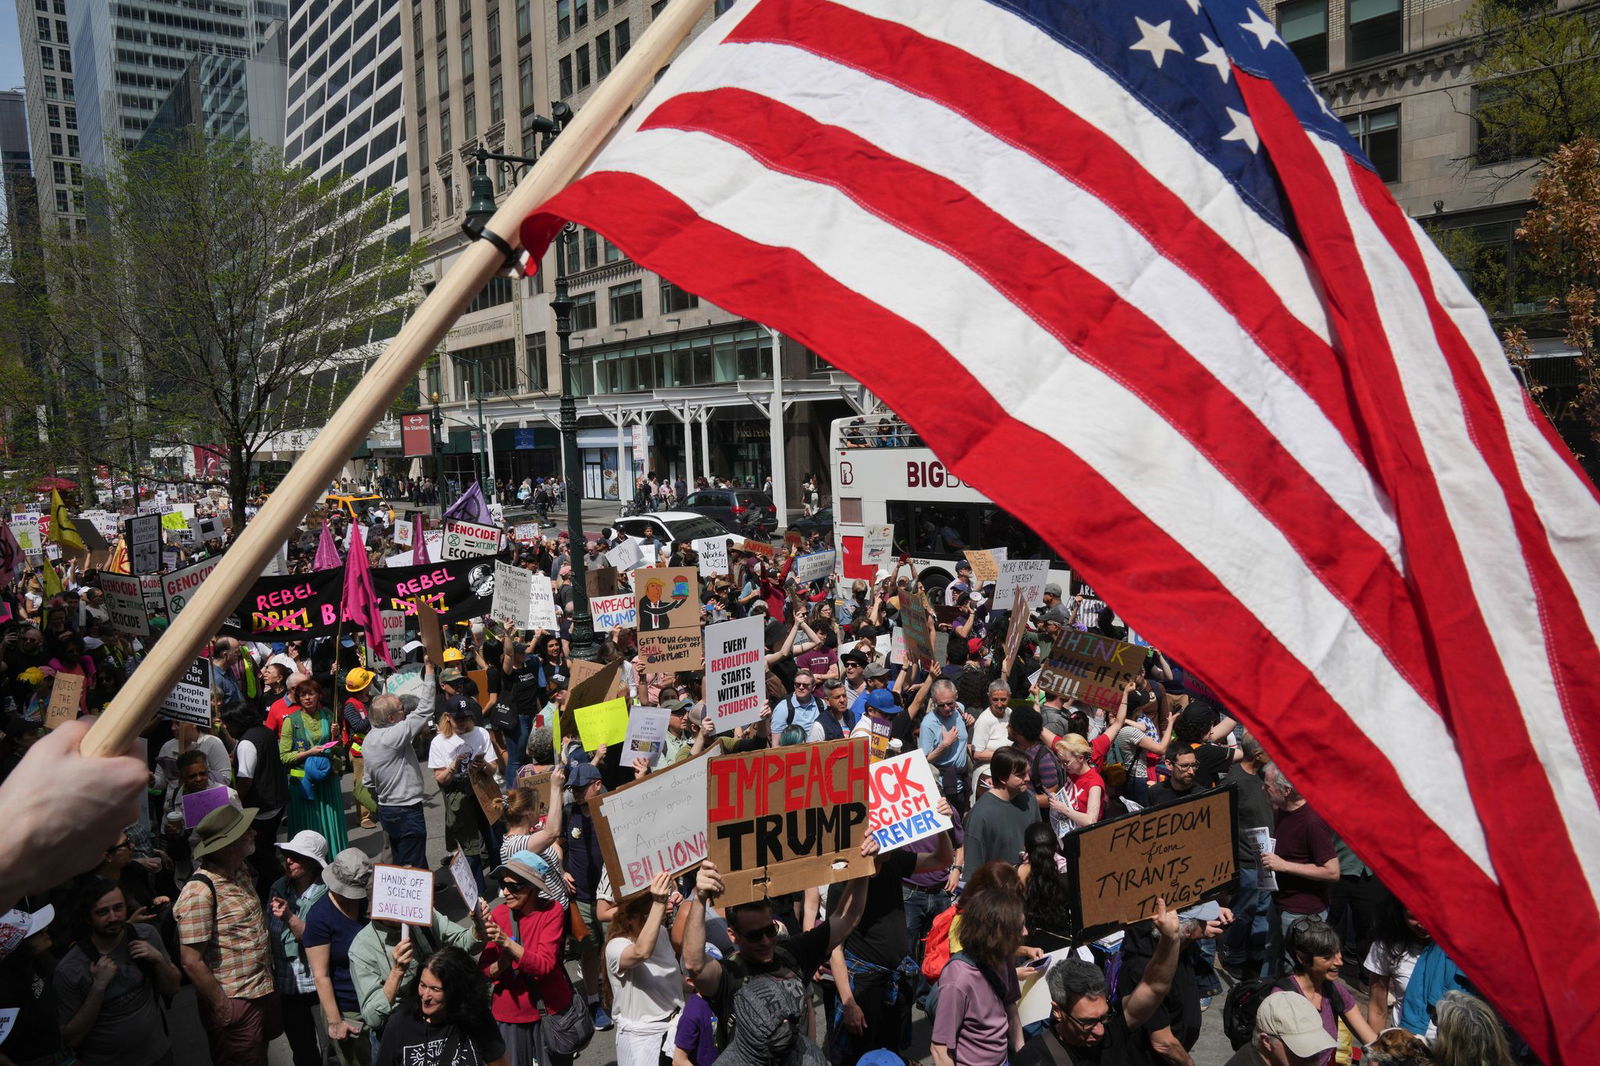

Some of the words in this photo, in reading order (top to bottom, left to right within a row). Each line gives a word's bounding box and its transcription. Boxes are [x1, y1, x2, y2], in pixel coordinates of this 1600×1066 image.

[514, 281, 522, 351] TOMETRY
[448, 523, 496, 541] GENOCIDE
[704, 541, 719, 551] You
[141, 580, 161, 589] OCIDE
[396, 568, 455, 597] REBEL
[1080, 584, 1095, 596] ARE
[256, 582, 317, 611] REBEL
[592, 596, 636, 614] IMPEACH
[382, 616, 403, 629] OCIDE
[597, 609, 636, 628] TRUMP
[639, 636, 656, 646] GET
[657, 635, 676, 644] YOUR
[723, 637, 747, 654] EVERY
[191, 666, 203, 675] Be
[711, 649, 759, 673] REVOLUTION
[721, 667, 751, 686] STARTS
[177, 685, 204, 697] People
[178, 693, 200, 704] Drive
[718, 684, 740, 703] WITH
[741, 680, 756, 697] THE
[1083, 684, 1124, 713] LEGA
[165, 700, 178, 708] om
[180, 702, 207, 714] Power
[718, 695, 759, 718] STUDENTS
[873, 721, 891, 736] BREAKS
[709, 740, 869, 823] IMPEACH
[869, 757, 925, 810] UCK
[607, 797, 634, 813] The
[869, 792, 931, 830] SCISM
[717, 802, 867, 871] TRUMP
[1110, 805, 1211, 852] FREEDOM
[627, 831, 708, 887] BILLIONA
[1141, 842, 1185, 863] from
[381, 873, 406, 886] HANDS
[410, 878, 424, 888] OFF
[1096, 856, 1192, 898] TYRANTS
[386, 886, 422, 900] SCIENCE
[1137, 877, 1206, 918] THUGS
[378, 902, 398, 916] SAVE
[401, 904, 423, 919] LIVES
